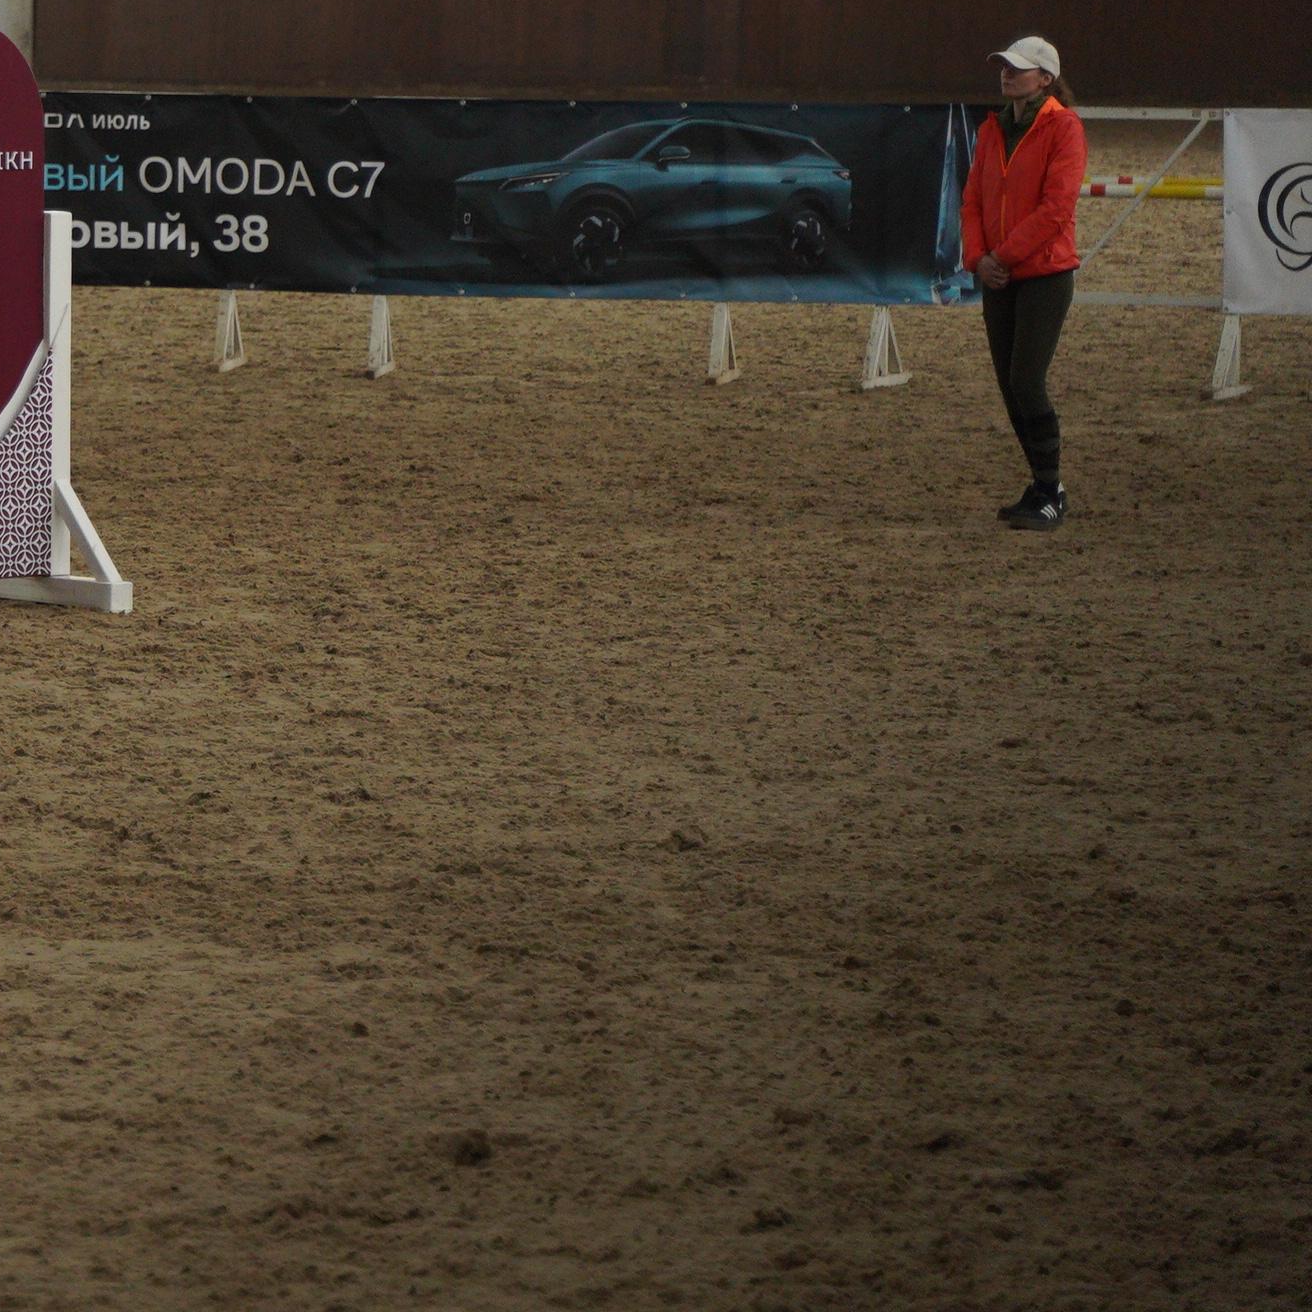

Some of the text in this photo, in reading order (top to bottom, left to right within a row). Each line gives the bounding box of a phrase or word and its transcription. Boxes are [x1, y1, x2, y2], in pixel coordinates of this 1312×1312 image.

[92, 113, 151, 131] июль
[44, 153, 386, 199] вый OMODA C7
[72, 211, 269, 259] овый, 38
